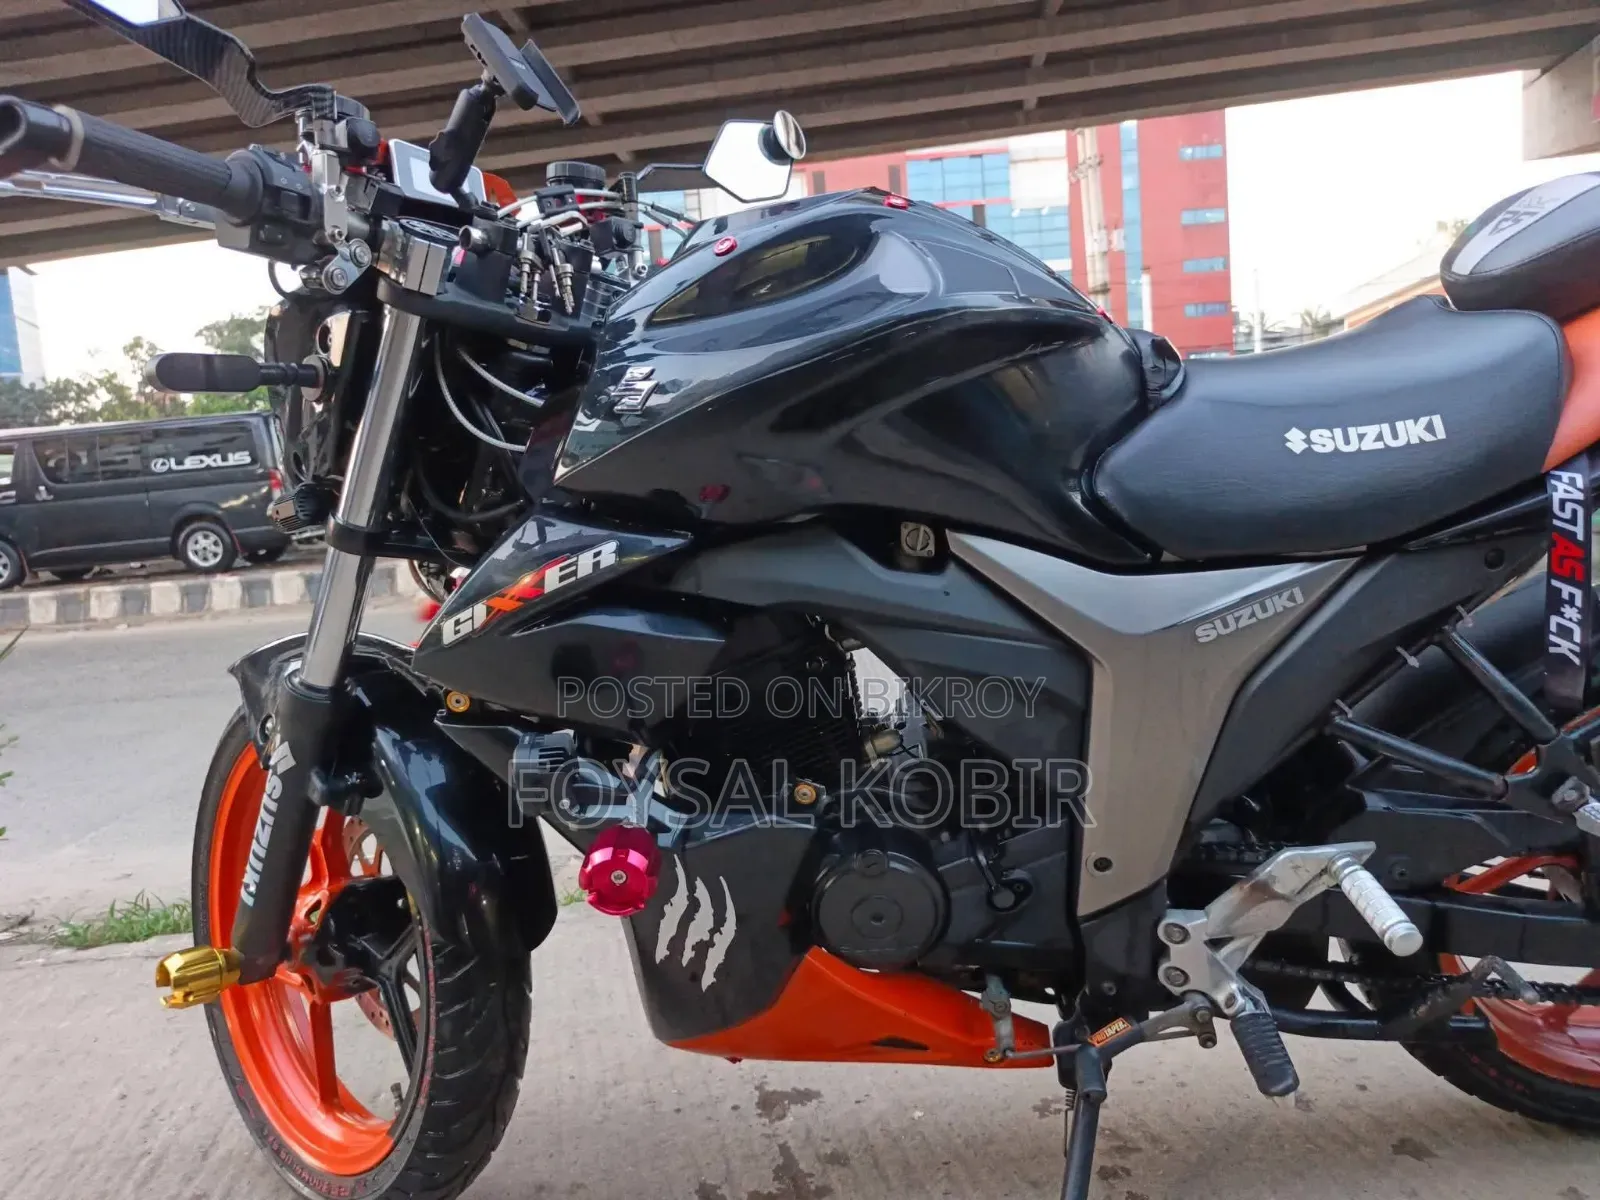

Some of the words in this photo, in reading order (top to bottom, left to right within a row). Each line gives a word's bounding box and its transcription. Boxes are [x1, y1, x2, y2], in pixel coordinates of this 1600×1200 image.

[169, 450, 252, 471] LEXUS
[1309, 414, 1447, 453] SUZUKI
[1551, 470, 1585, 541] FAST
[1551, 532, 1585, 583] AS
[1195, 586, 1304, 643] SUZUKI
[240, 769, 284, 907] SUZUKI
